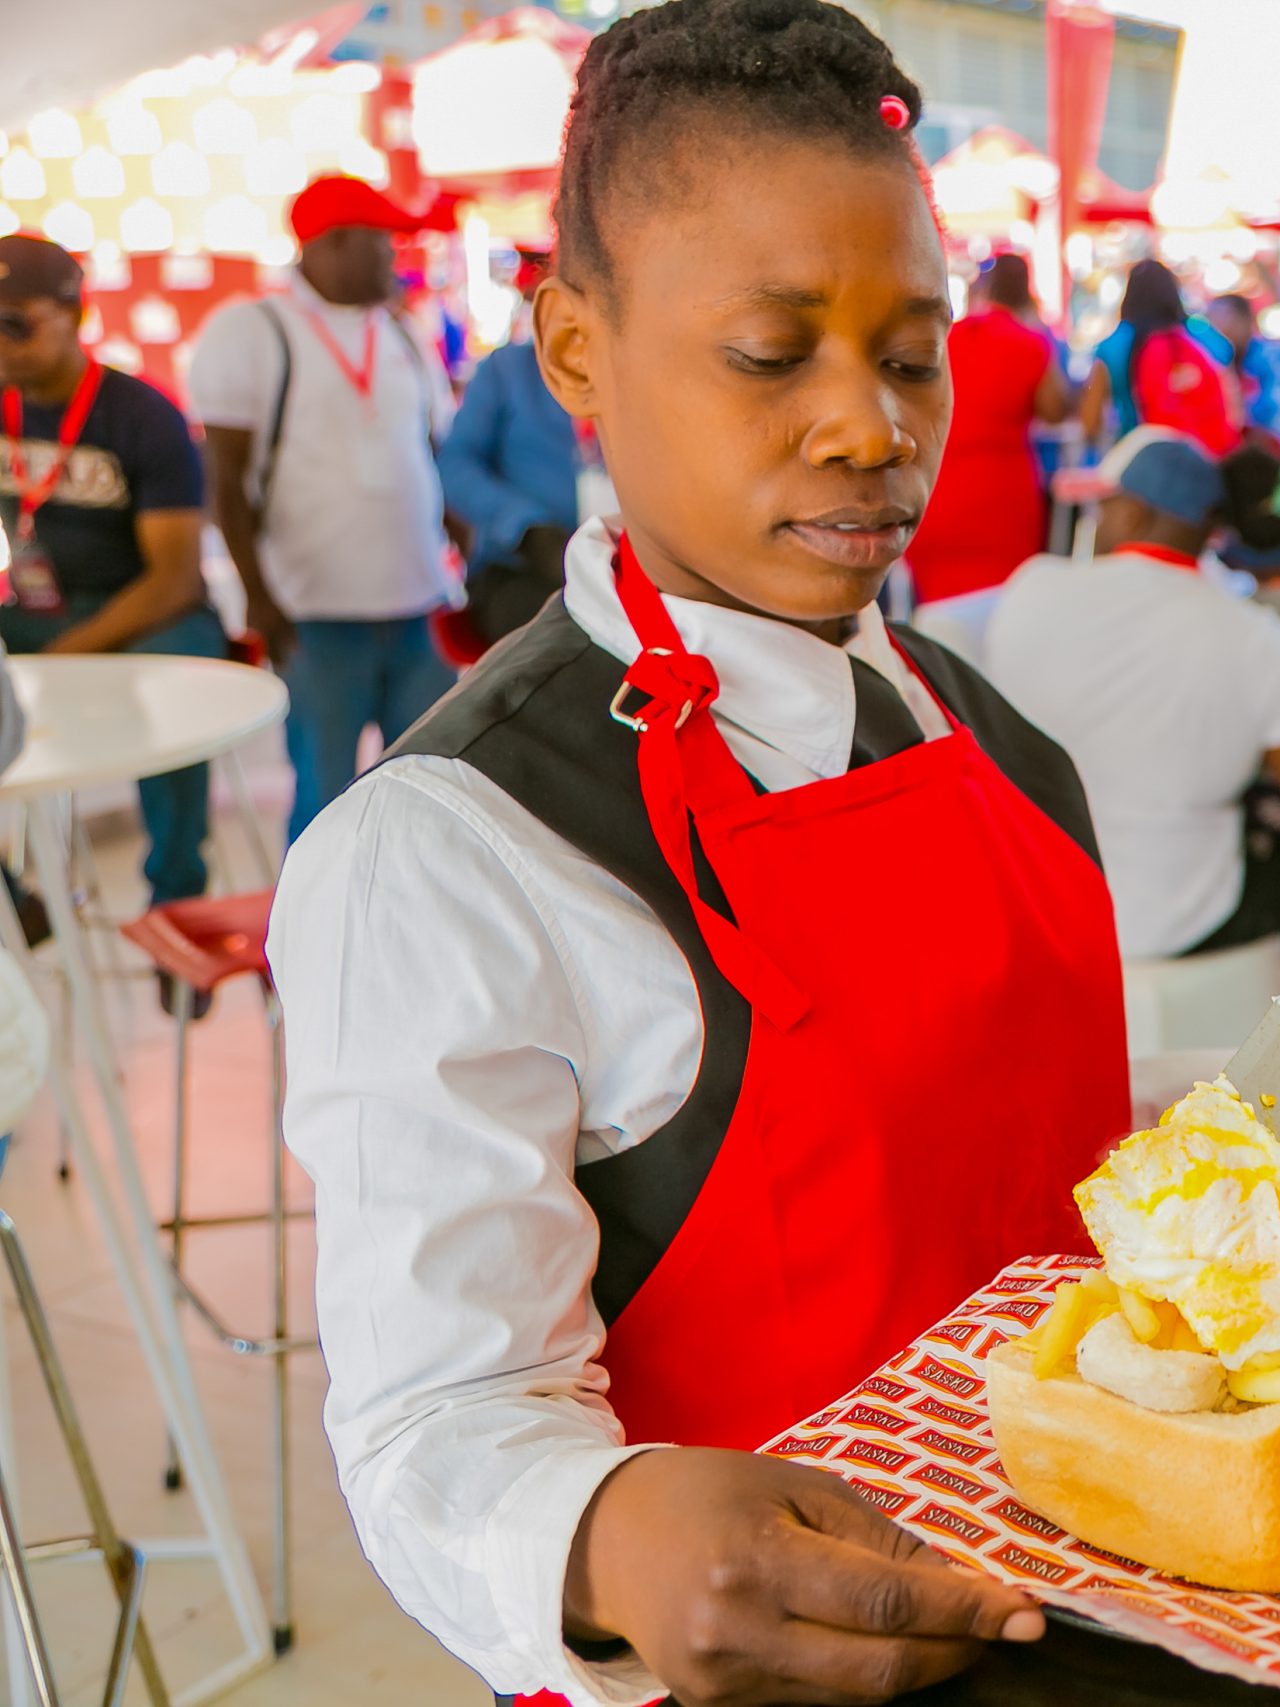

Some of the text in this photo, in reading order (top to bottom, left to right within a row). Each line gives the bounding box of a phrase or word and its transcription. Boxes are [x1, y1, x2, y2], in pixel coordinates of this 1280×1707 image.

[920, 1363, 977, 1395] SASKO
[847, 1408, 905, 1429] SASKO
[921, 1401, 978, 1424] SASKO
[778, 1438, 831, 1452] SASKO
[846, 1443, 905, 1466] SASKO
[921, 1432, 980, 1458] SASKO
[921, 1468, 982, 1496] SASKO
[922, 1508, 984, 1540] SASKO
[1000, 1503, 1061, 1535] SASKO
[1002, 1548, 1067, 1580] SASKO
